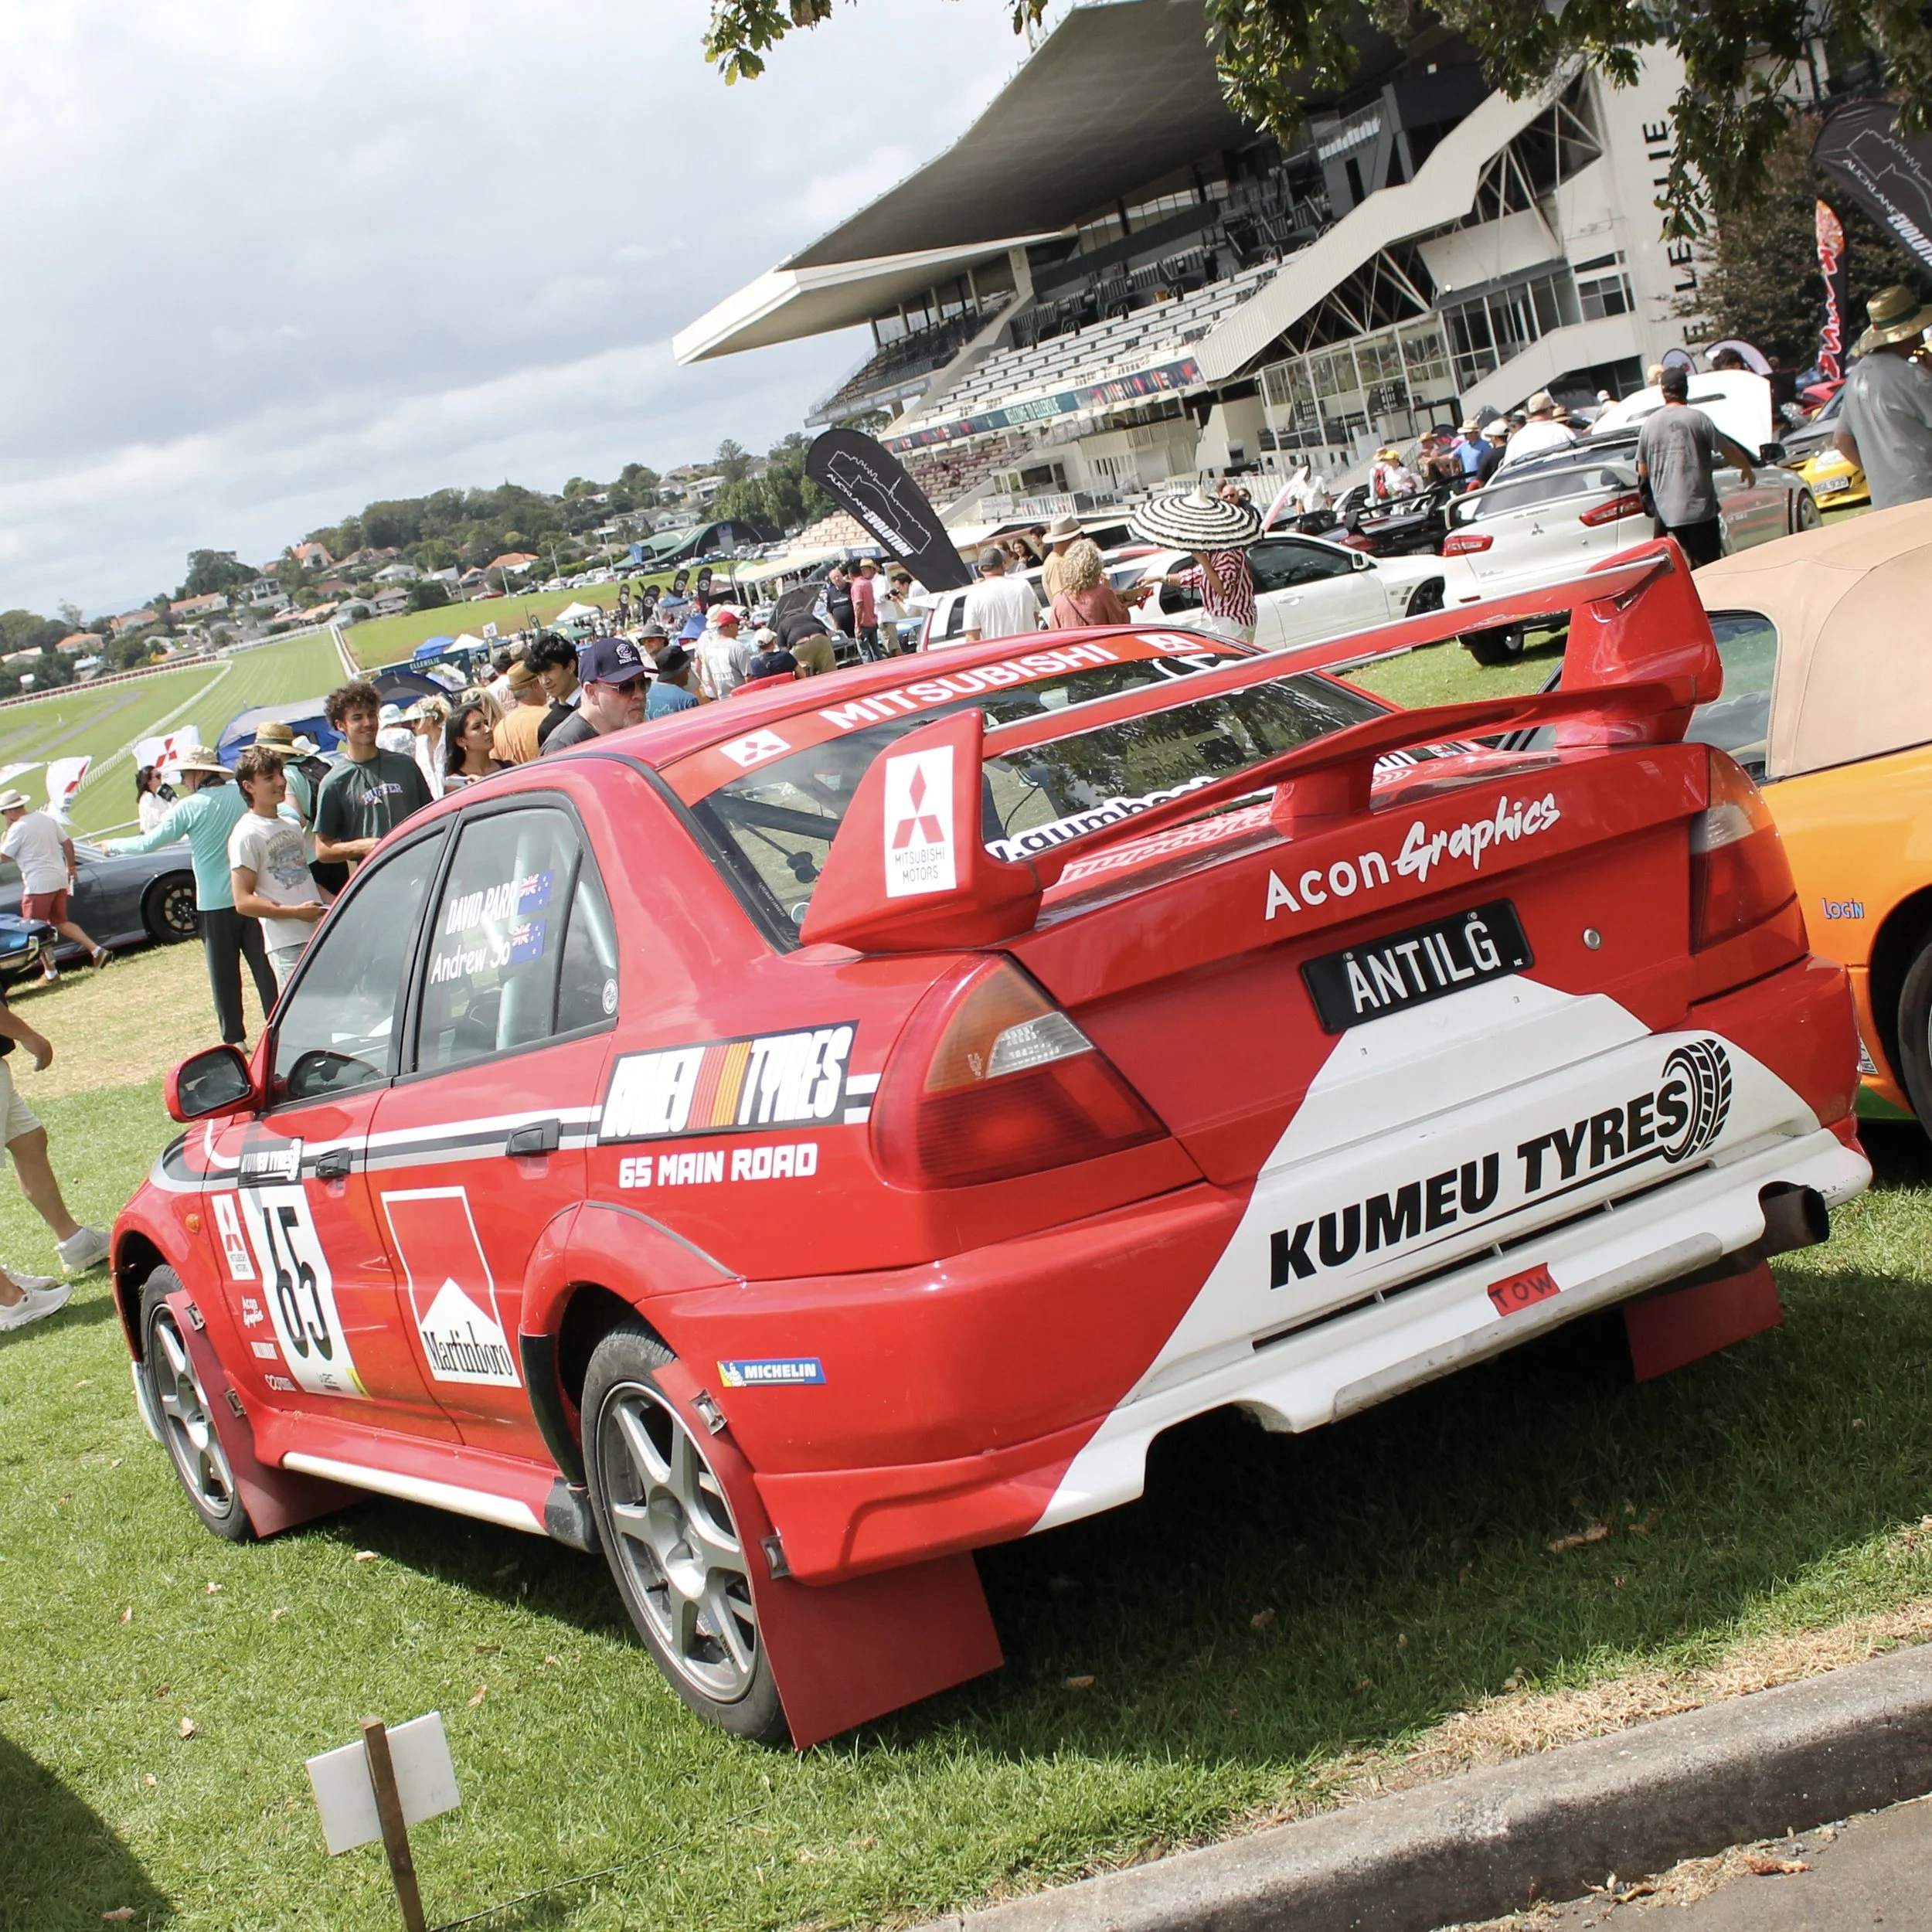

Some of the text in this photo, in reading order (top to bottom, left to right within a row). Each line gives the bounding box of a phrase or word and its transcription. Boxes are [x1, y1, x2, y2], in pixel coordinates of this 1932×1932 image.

[1843, 158, 1899, 215] AUCKLAND
[826, 473, 871, 515] AUCKLAND
[862, 511, 914, 557] EVOLUTION
[818, 643, 1120, 730] MITSUBISHI
[894, 846, 945, 866] MITSUBISHI
[902, 865, 939, 883] MOTORS
[445, 880, 519, 935] DAVID PARR
[430, 944, 488, 985] Andrew
[1345, 920, 1502, 1015] ANTILG
[736, 1026, 854, 1126] TYRES
[619, 1142, 818, 1189] 65 MAIN ROAD
[1270, 1079, 1689, 1291] KUMEU TYRES
[262, 1206, 333, 1361] 65
[1488, 1276, 1553, 1308] TOW
[422, 1321, 514, 1378] Martinboro
[743, 1363, 817, 1379] MICHELIN
